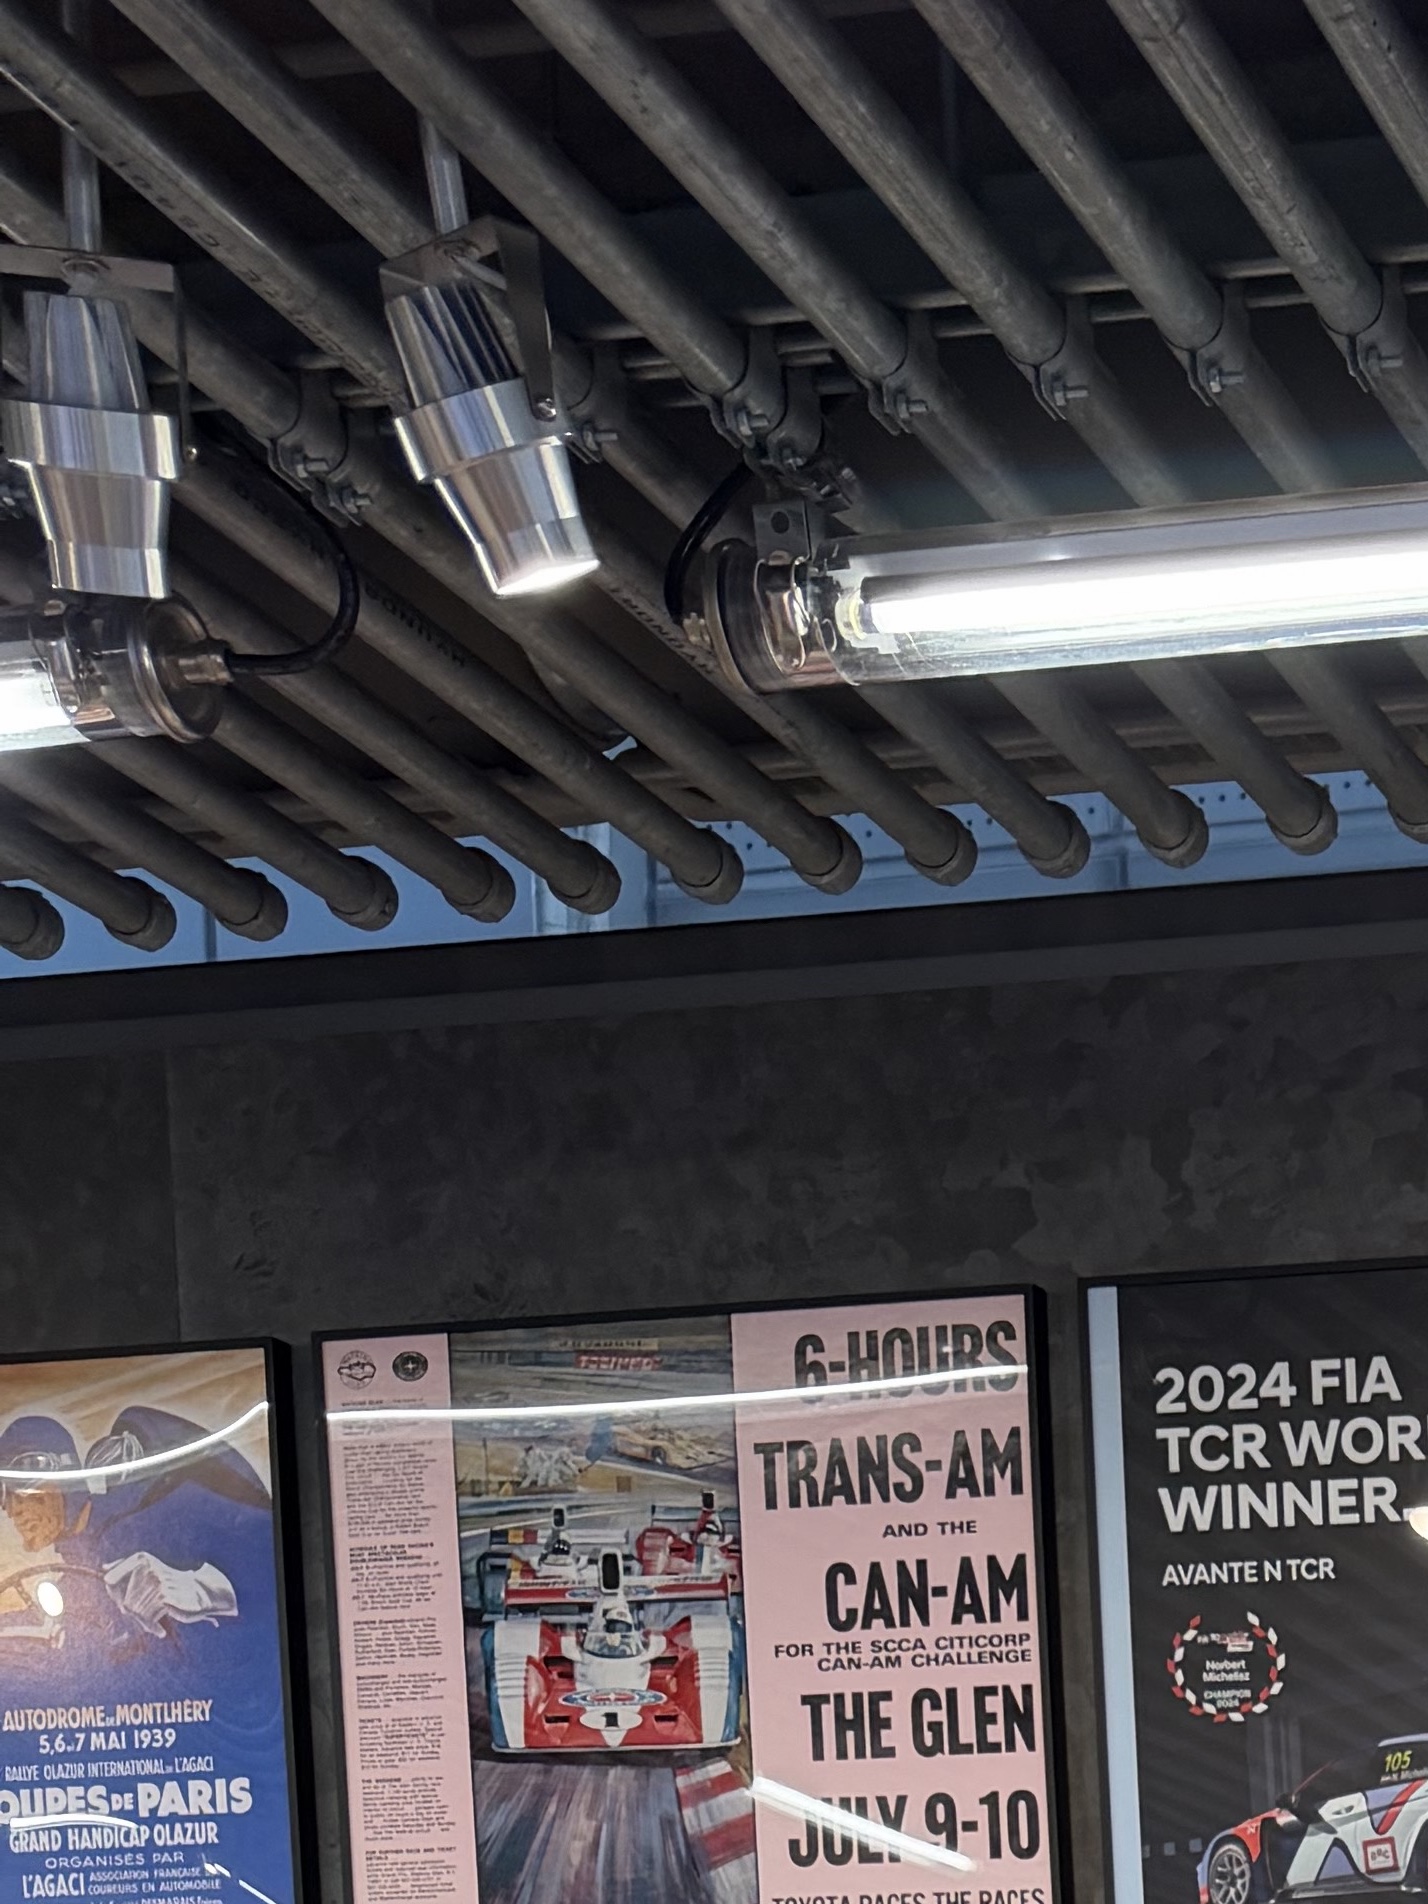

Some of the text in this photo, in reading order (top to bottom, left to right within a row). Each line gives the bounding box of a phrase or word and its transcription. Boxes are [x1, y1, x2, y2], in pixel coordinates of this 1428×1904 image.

[794, 1320, 1018, 1404] 6-HOURS
[1155, 1356, 1402, 1414] 2024 FIA
[1156, 1422, 1272, 1473] TCR
[753, 1426, 1024, 1511] TRANS-AM
[882, 1520, 978, 1538] AND THE
[1161, 1557, 1336, 1586] AVANTE N TCR
[824, 1553, 1030, 1632] CAN-AM
[773, 1633, 1031, 1658] FOR THE SCCA CITICORP
[816, 1650, 1032, 1671] CAN-AM CHALLENGE
[2, 1706, 106, 1732] AUTODROME
[800, 1684, 1036, 1762] THE GLEN
[90, 1728, 177, 1751] MAI 1939
[5, 1758, 165, 1782] RALLYE OLAZUR INTERNATIONAL
[1384, 1750, 1413, 1773] 105
[111, 1777, 253, 1818] DE PARIS
[9, 1821, 219, 1853] GRAND HANDICAP OLAZUR
[788, 1789, 1041, 1868] JULY 9-10
[153, 1851, 184, 1864] PAR
[22, 1872, 85, 1899] L'AGACI
